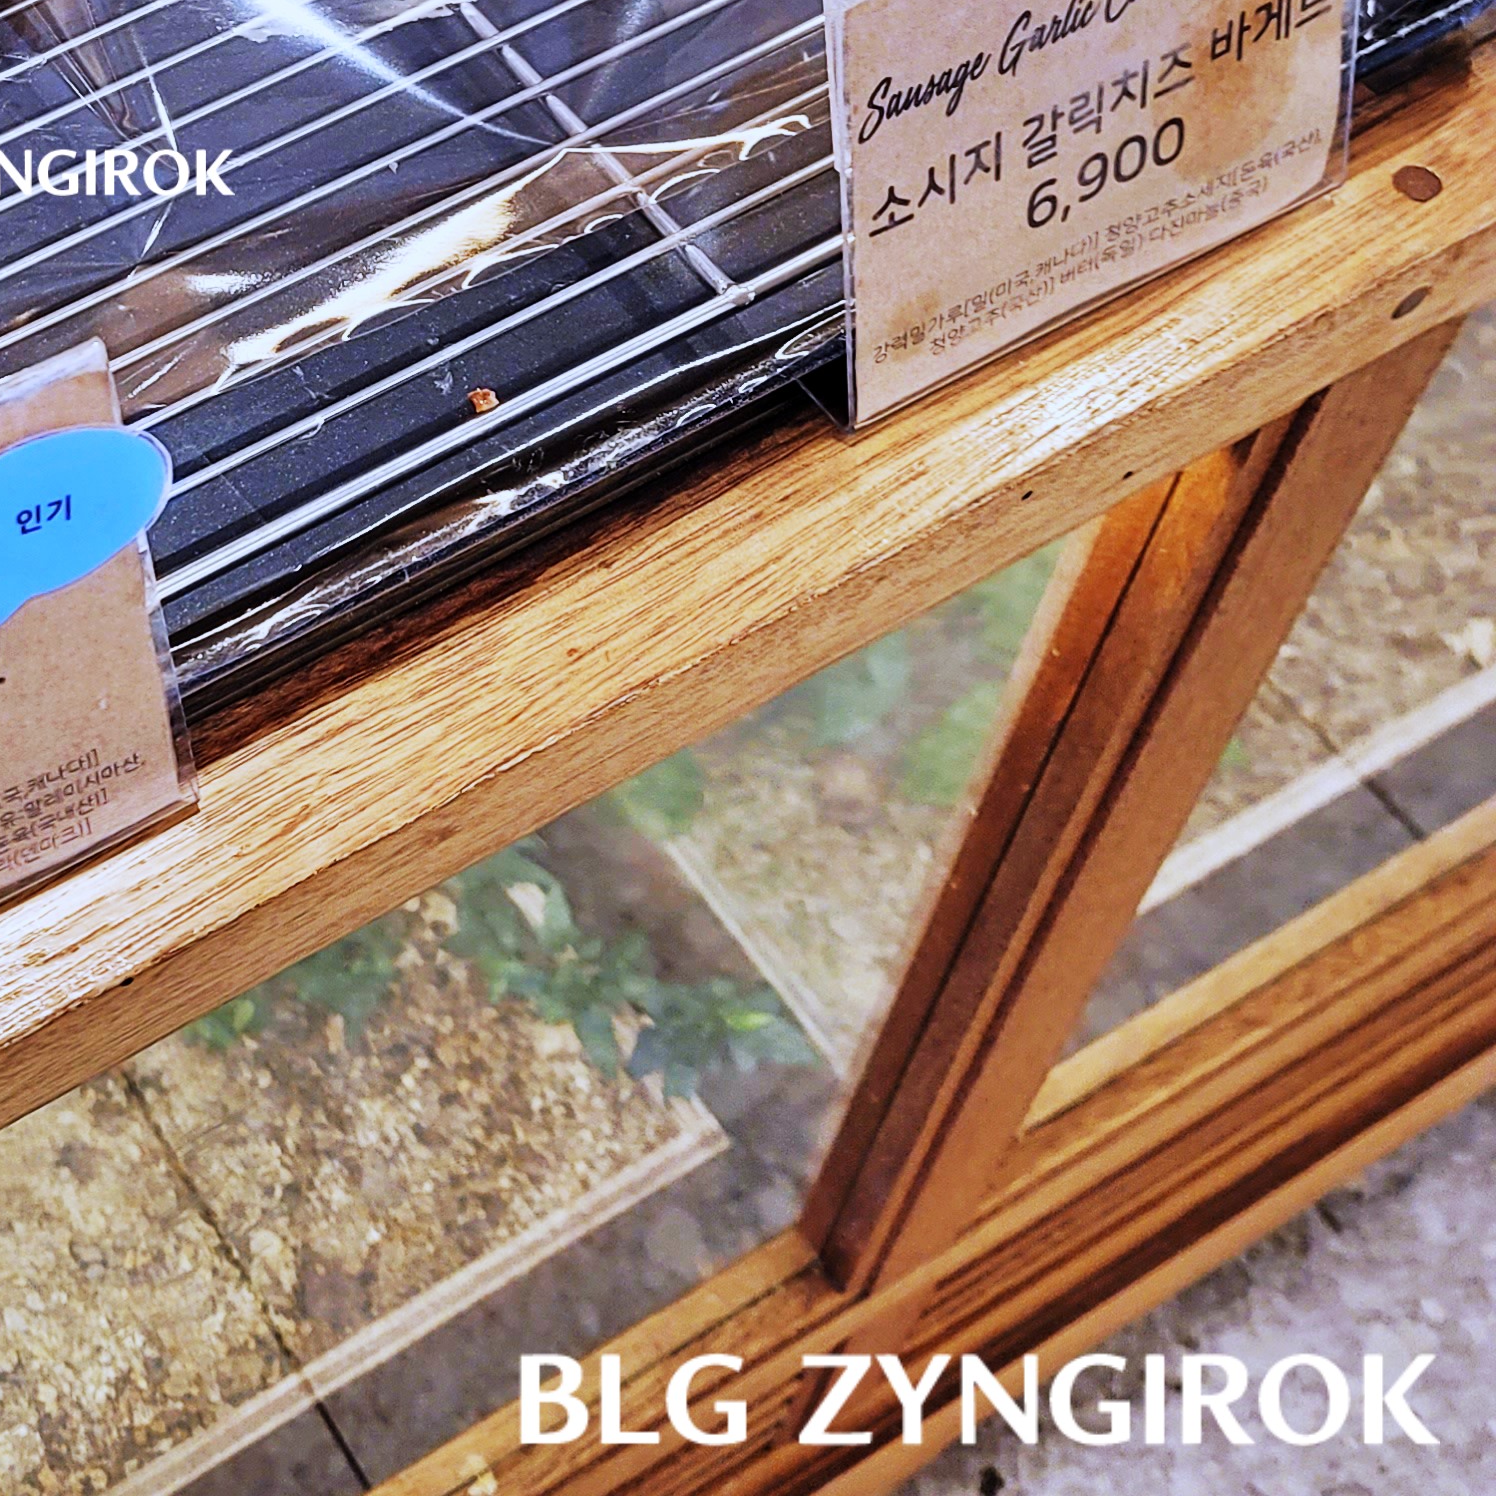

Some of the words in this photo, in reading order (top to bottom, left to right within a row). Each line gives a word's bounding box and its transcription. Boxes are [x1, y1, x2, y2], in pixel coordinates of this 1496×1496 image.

[857, 51, 991, 144] Sausage
[868, 131, 1001, 237] 소시지
[1022, 45, 1195, 168] 갈릭치즈
[1027, 116, 1184, 228] 6,900
[16, 495, 70, 534] 인기
